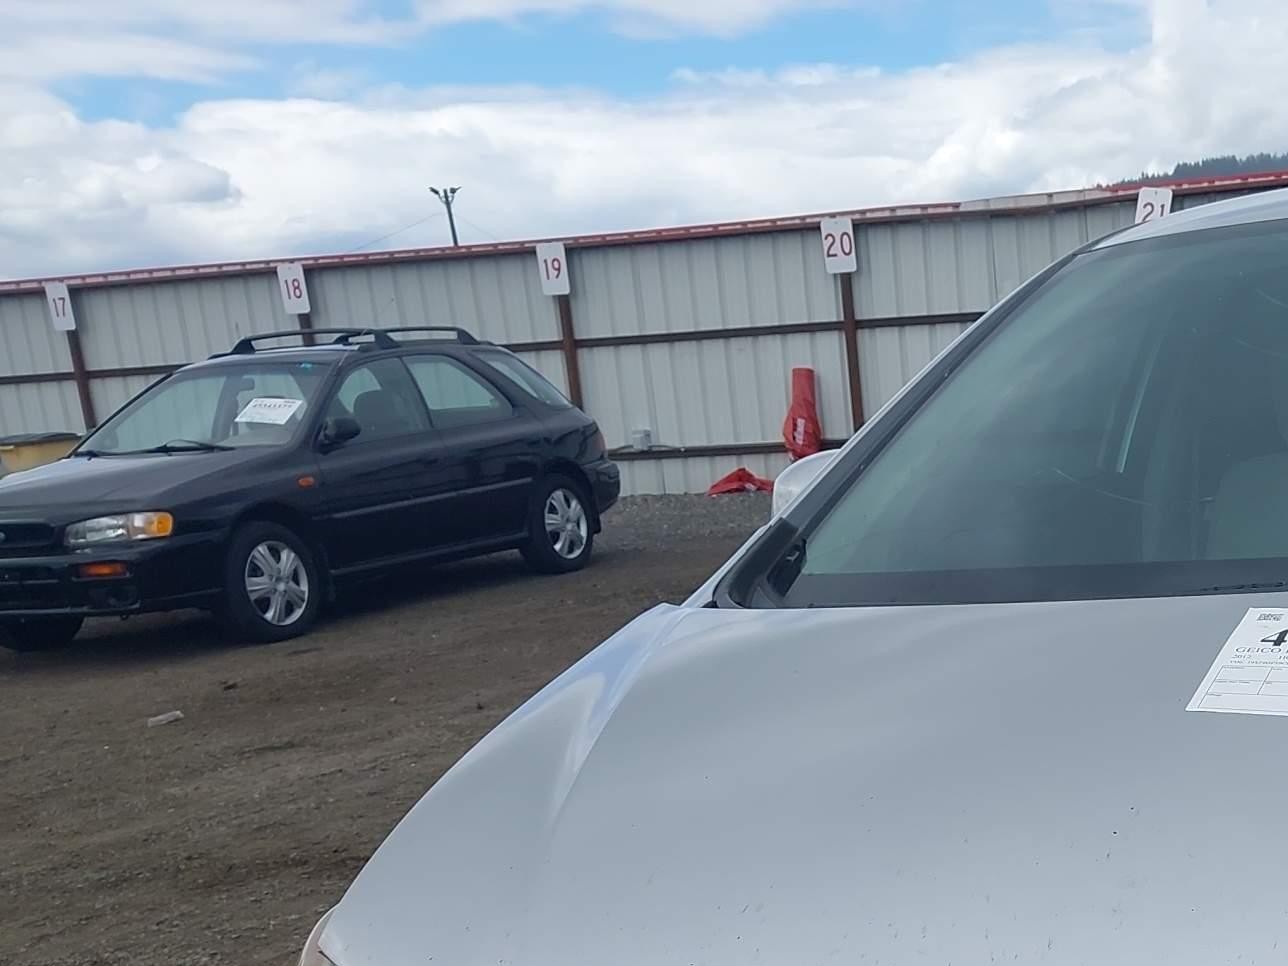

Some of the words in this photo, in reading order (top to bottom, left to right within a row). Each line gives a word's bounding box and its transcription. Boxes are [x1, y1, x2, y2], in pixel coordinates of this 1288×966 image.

[1142, 202, 1166, 222] 21
[824, 231, 853, 257] 20
[543, 257, 562, 280] 19
[284, 278, 303, 300] 18
[52, 297, 66, 318] 17
